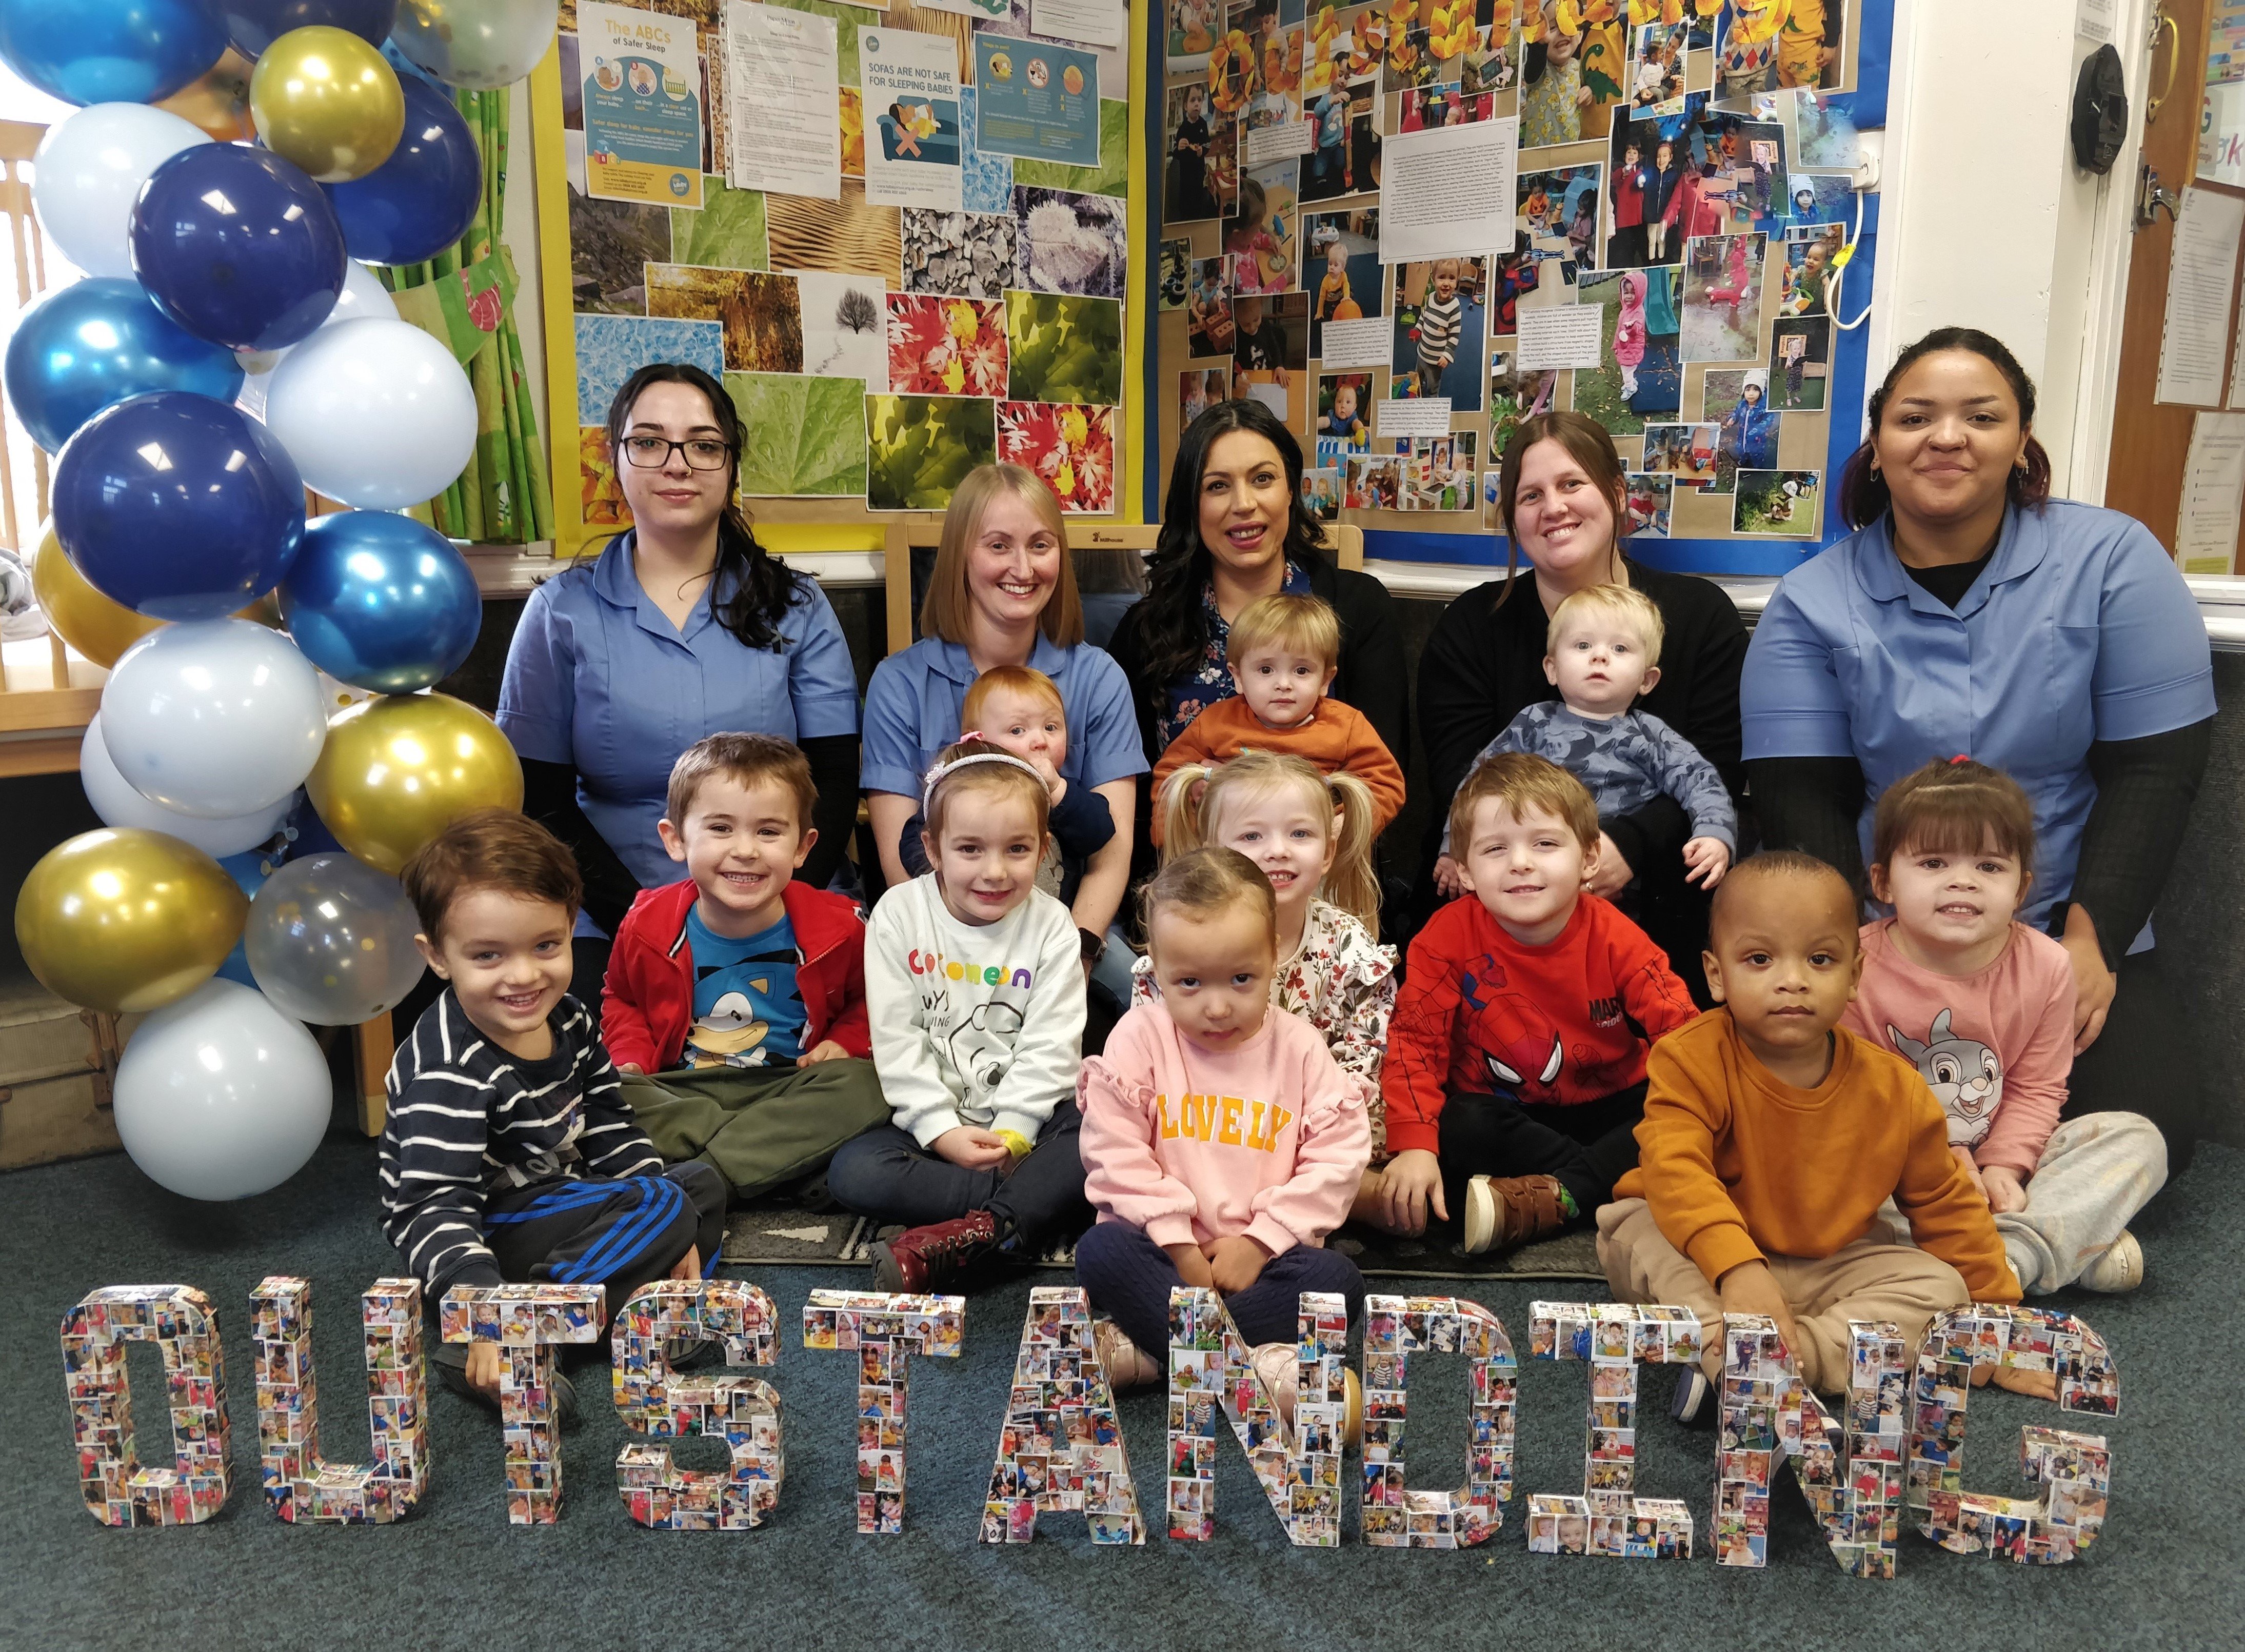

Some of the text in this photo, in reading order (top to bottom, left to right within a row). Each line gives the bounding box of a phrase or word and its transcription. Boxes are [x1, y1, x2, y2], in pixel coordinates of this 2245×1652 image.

[605, 19, 671, 44] The ABCs
[623, 38, 643, 48] Safer
[646, 42, 666, 53] Sleep
[868, 63, 951, 82] SOFAS ARE NOT SAFE
[869, 76, 953, 94] FOR SLEEPING BABIES
[1157, 1092, 1295, 1154] LOVELY
[60, 1276, 2121, 1579] OUTSTANDING
